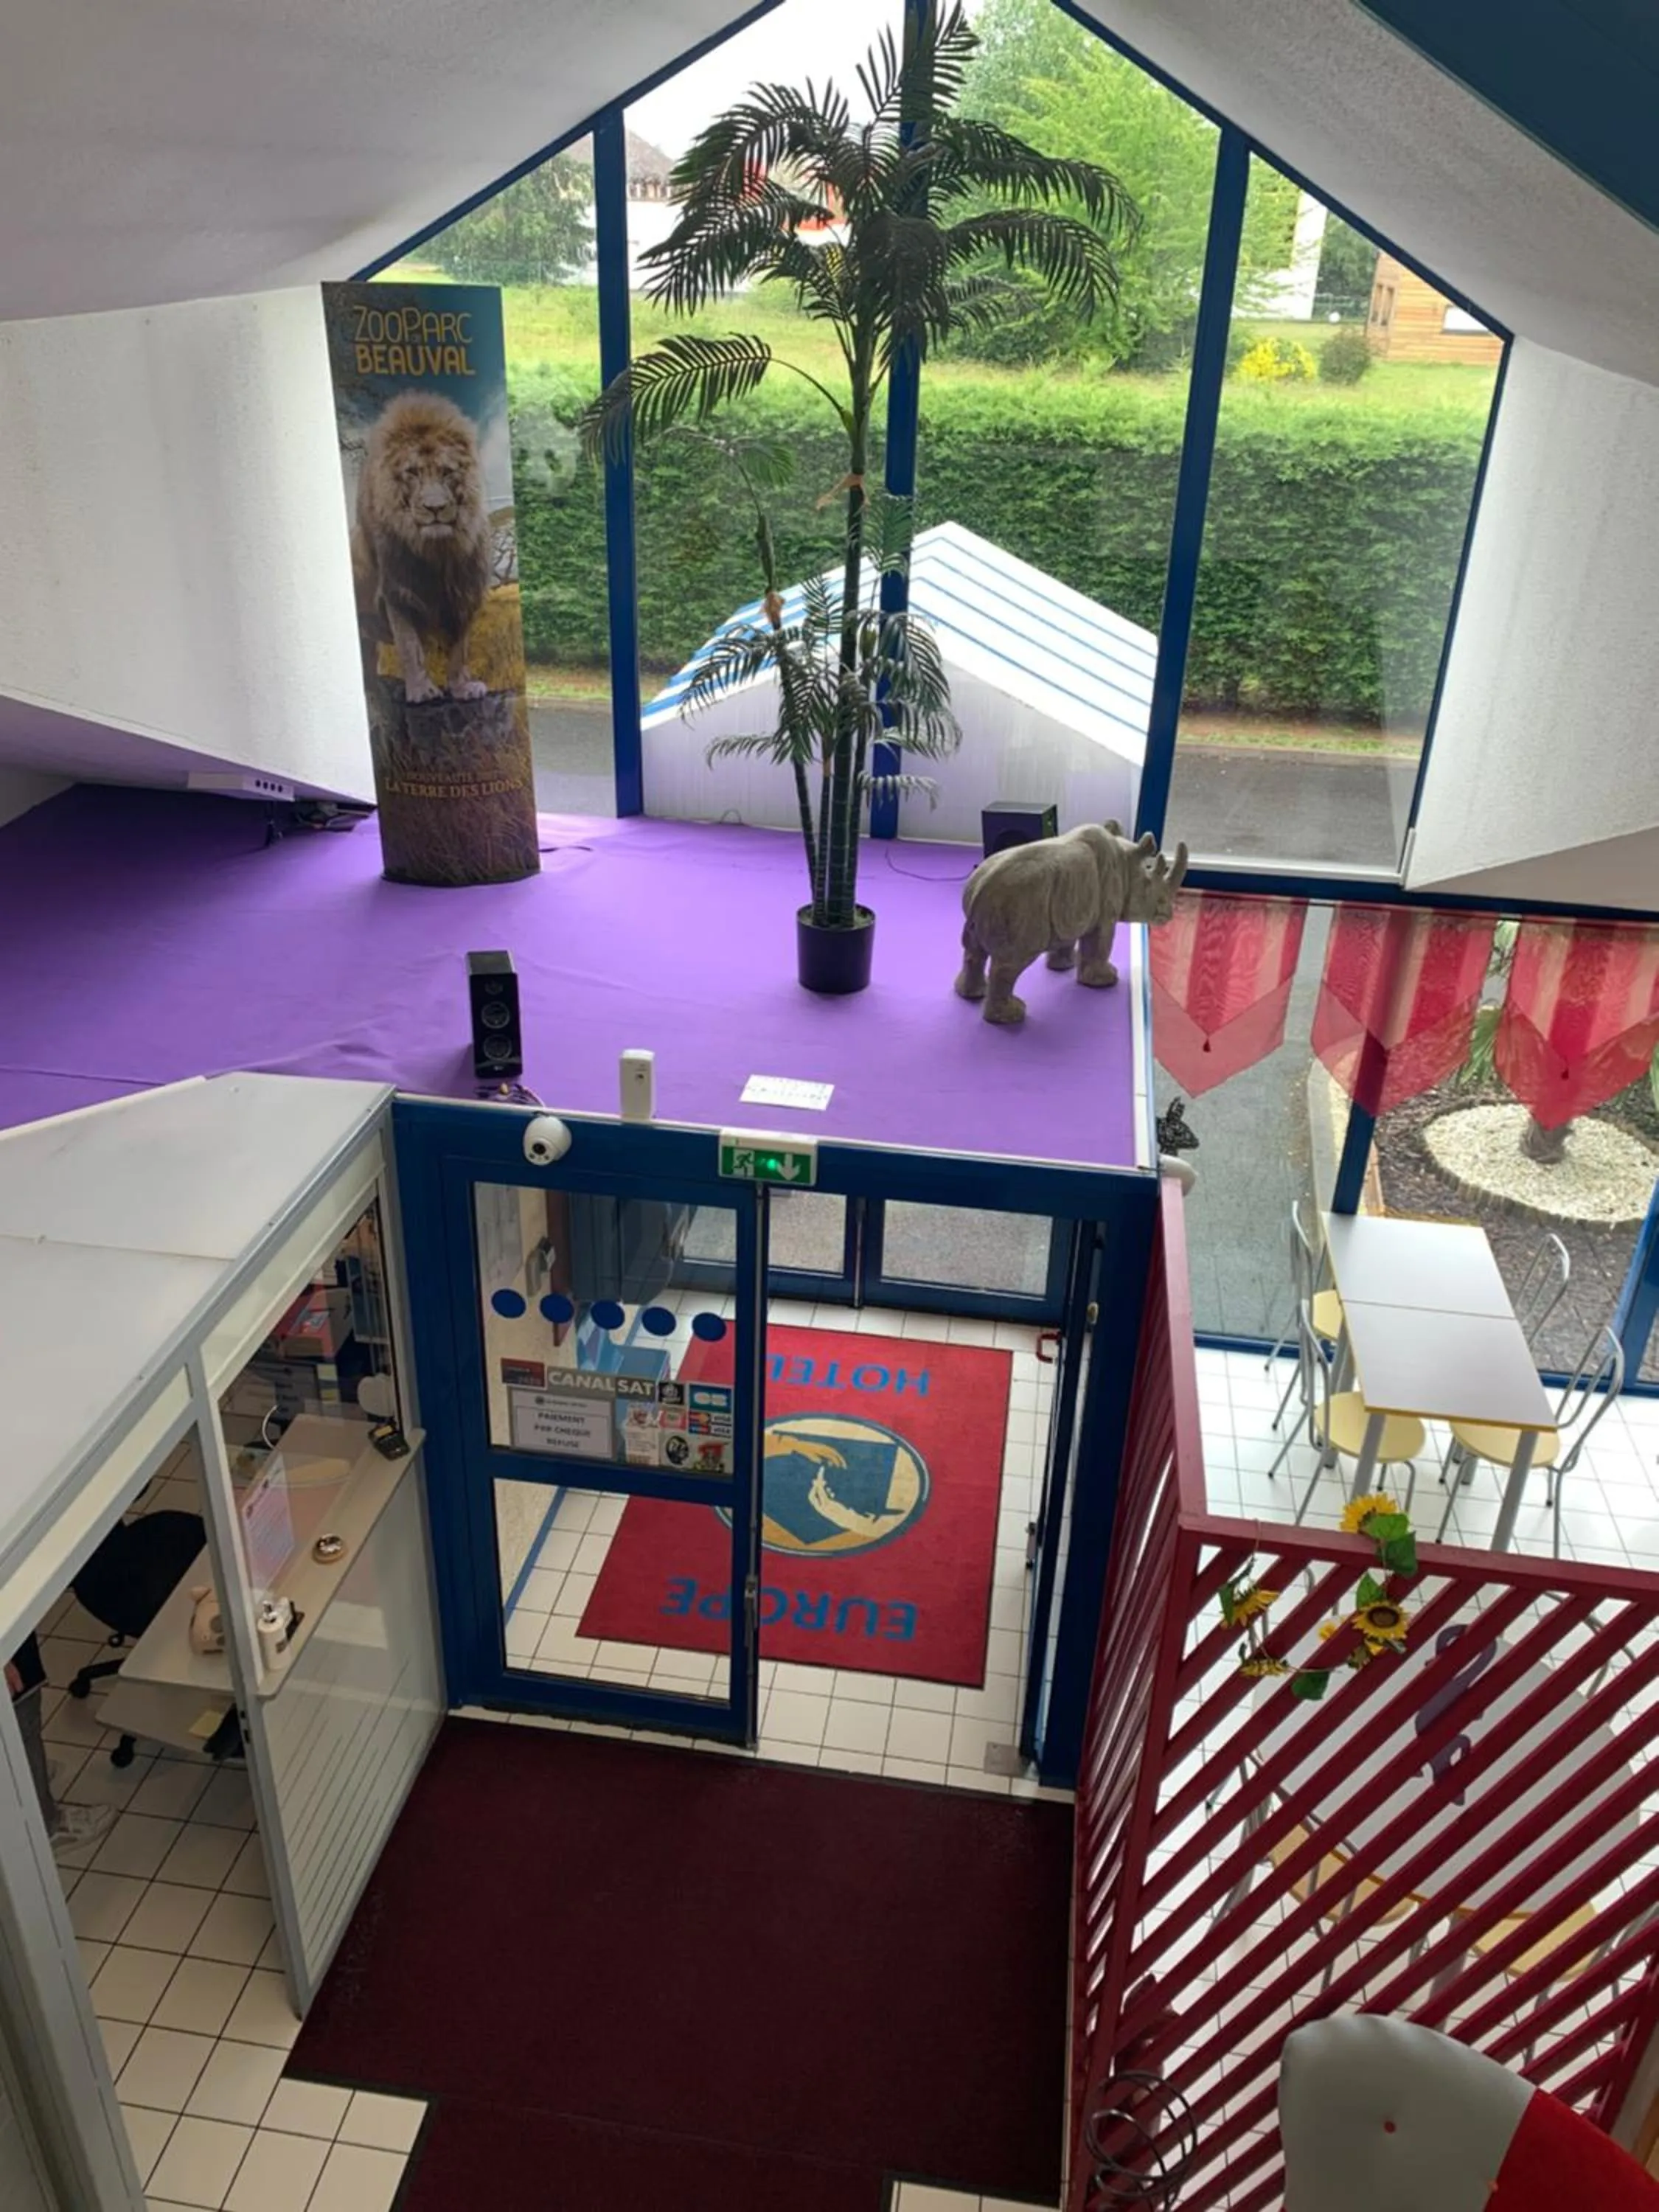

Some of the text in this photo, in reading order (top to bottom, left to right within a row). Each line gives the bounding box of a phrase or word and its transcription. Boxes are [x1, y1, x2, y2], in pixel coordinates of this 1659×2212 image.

[356, 344, 476, 375] BEAUVAL
[385, 778, 523, 798] LA TERRE DES LIONS
[766, 1354, 929, 1395] HOTEL
[662, 1577, 918, 1639] EUROPE
